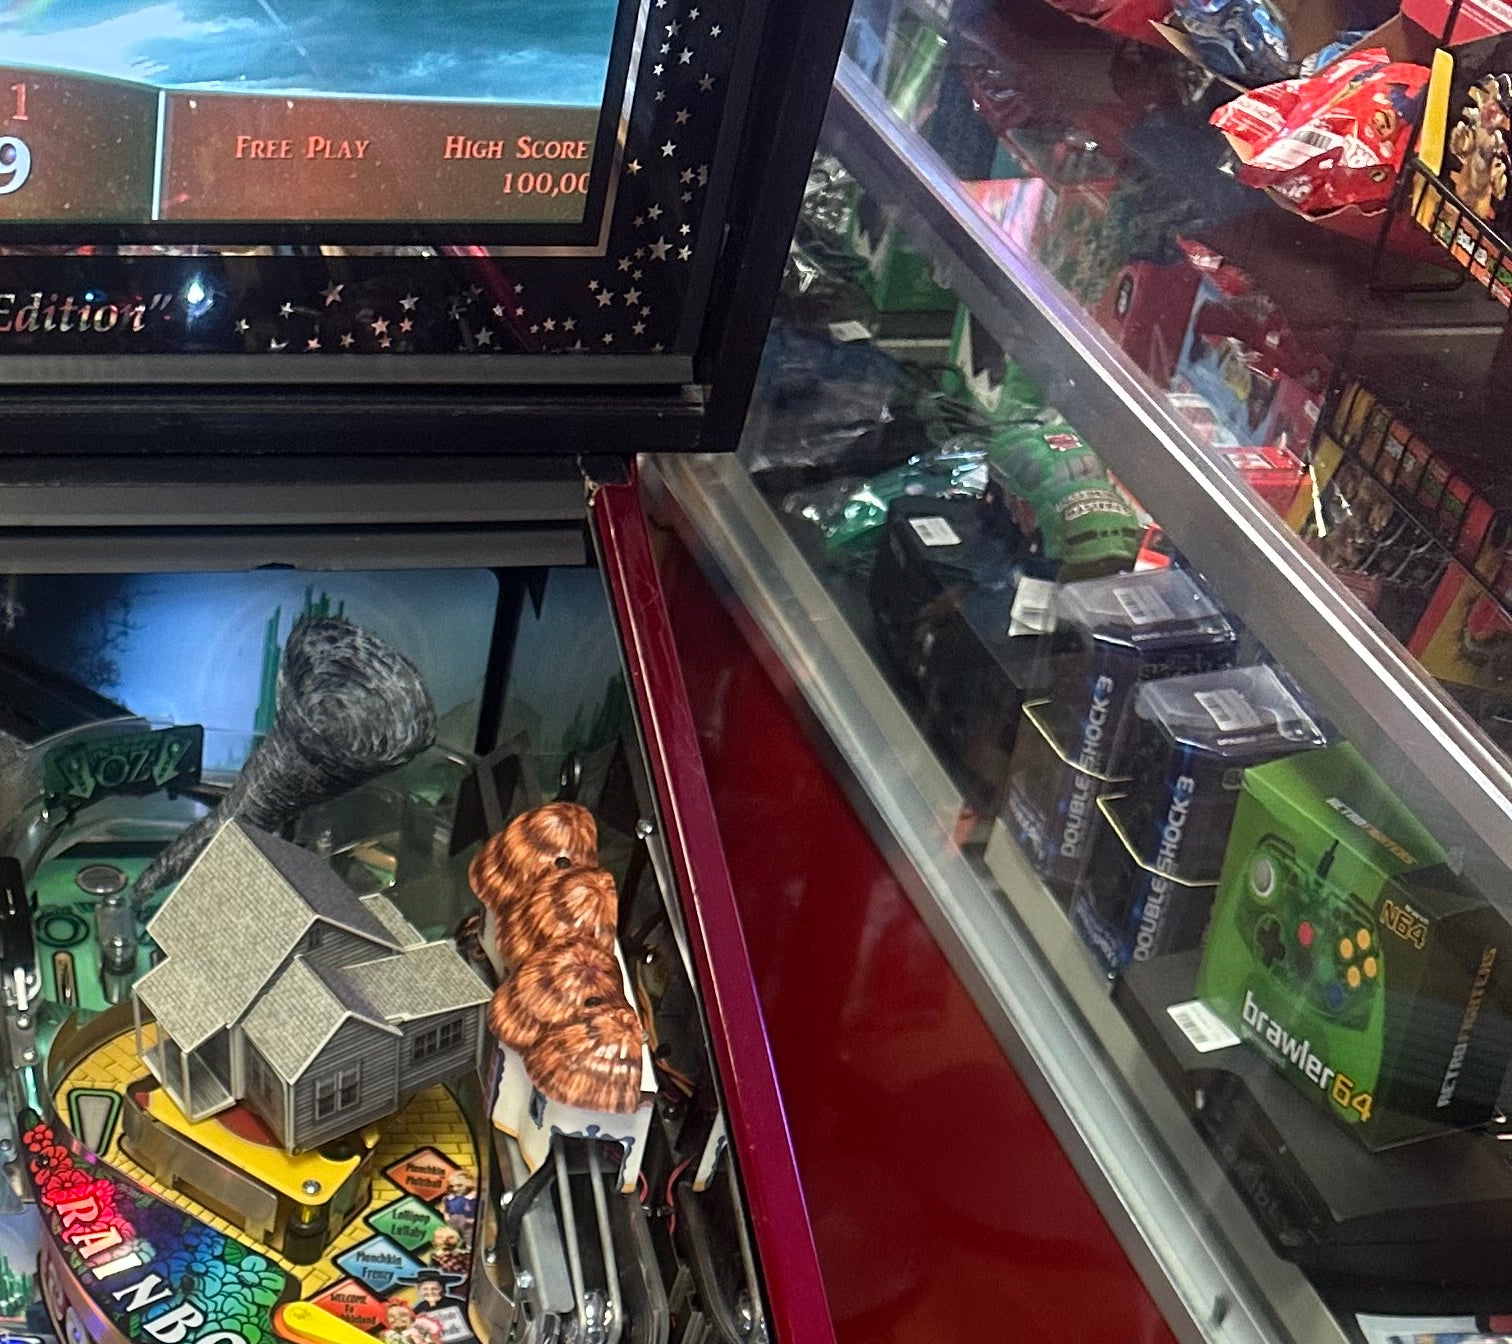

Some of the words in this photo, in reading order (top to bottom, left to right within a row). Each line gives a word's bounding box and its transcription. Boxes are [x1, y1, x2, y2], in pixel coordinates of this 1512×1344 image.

[13, 83, 29, 120] 1
[235, 135, 293, 160] FREE
[306, 135, 369, 160] PLAY
[444, 135, 503, 160] HIGH
[516, 135, 589, 160] SCORE
[1379, 899, 1430, 951] N64
